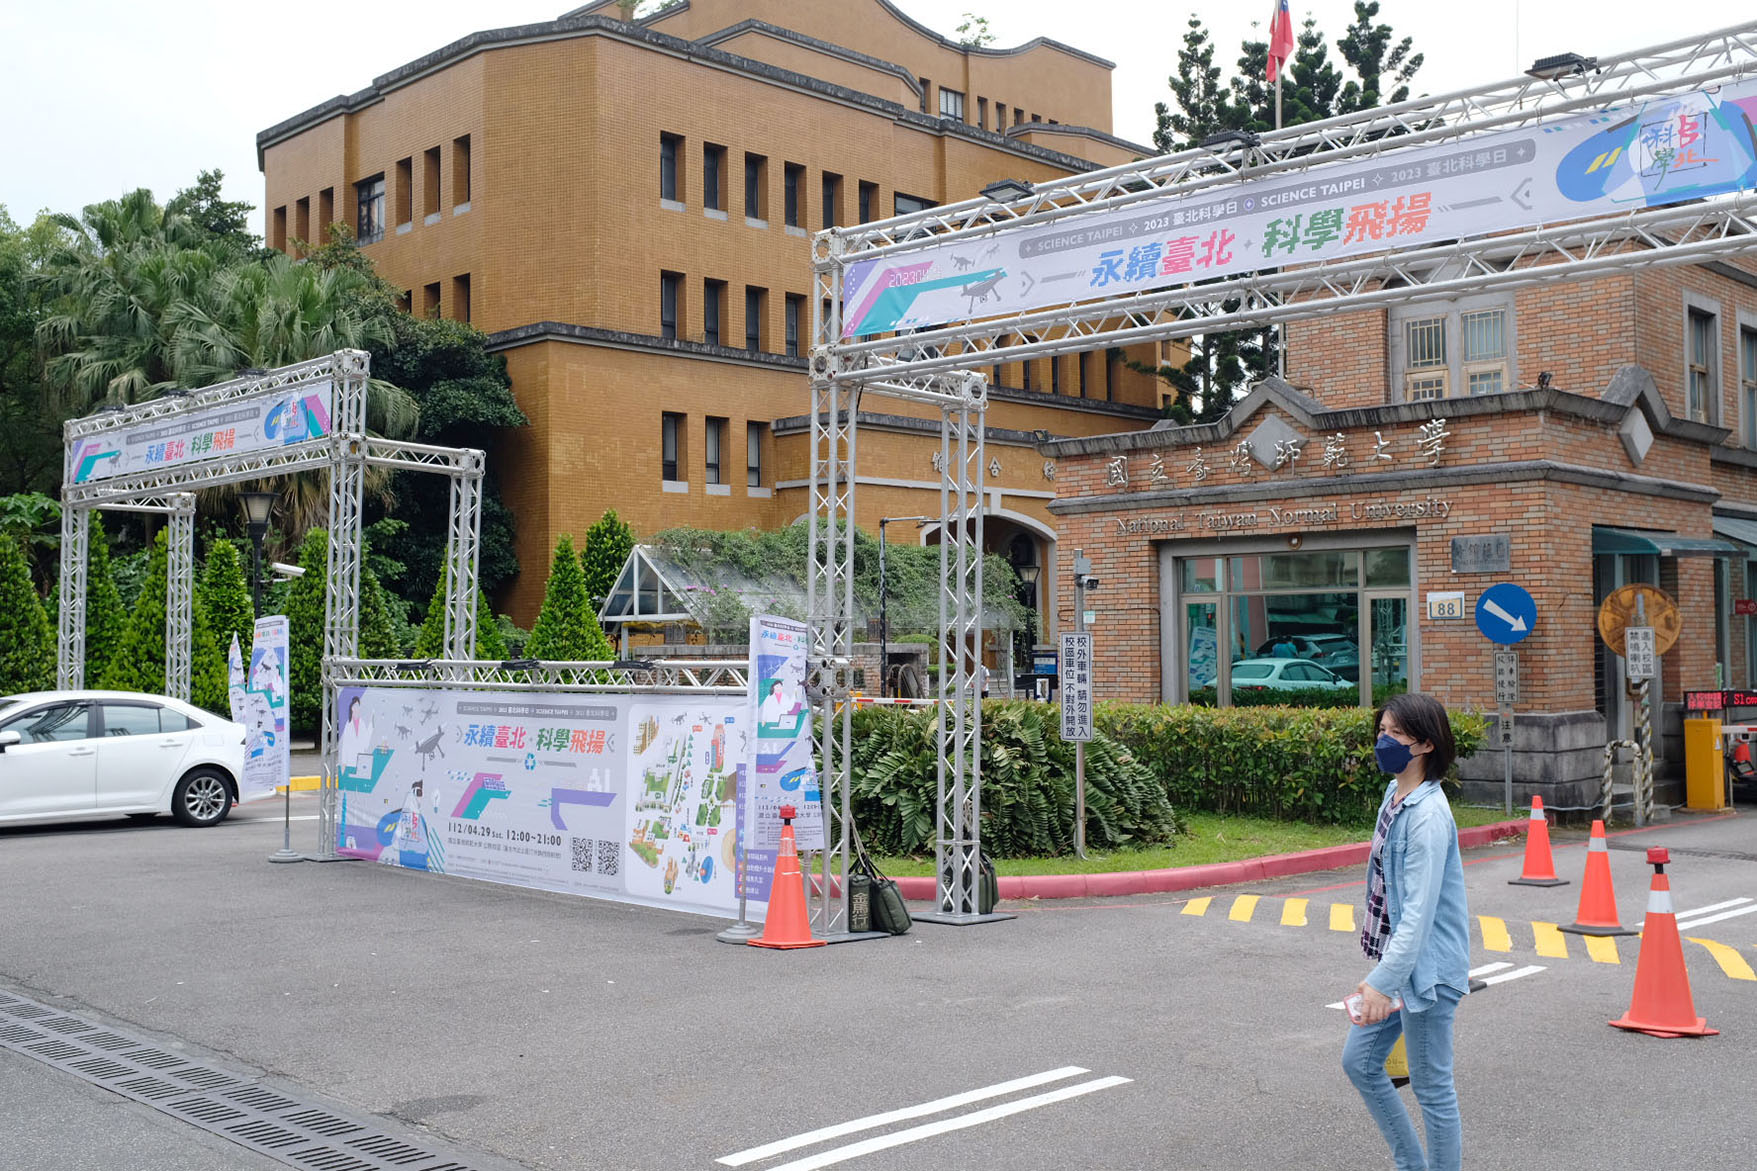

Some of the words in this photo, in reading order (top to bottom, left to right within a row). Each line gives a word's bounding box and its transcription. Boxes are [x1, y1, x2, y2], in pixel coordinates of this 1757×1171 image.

[1391, 168, 1422, 183] 2023
[1426, 149, 1507, 177] 臺北科學日
[1260, 186, 1317, 207] SCIENCE
[1320, 177, 1365, 197] TAIPEI
[1143, 218, 1170, 232] 2023
[1172, 201, 1238, 226] 臺北科學日
[1037, 232, 1084, 251] SCIENCE
[1087, 225, 1123, 243] TAIPEI
[1089, 228, 1236, 288] 永續臺北
[1263, 192, 1432, 258] 科學飛揚
[1116, 512, 1186, 537] National
[1195, 509, 1258, 531] Taiwan
[1268, 502, 1338, 527] Normal
[1349, 495, 1453, 521] University
[1438, 602, 1455, 616] 88
[1065, 637, 1075, 680] 校區車位
[1076, 637, 1088, 685] 校外車輛
[1065, 683, 1076, 737] 不對外開放
[1076, 689, 1088, 737] 請勿進入
[464, 724, 526, 749] 永續臺北
[536, 727, 606, 754] 科學飛揚
[1501, 720, 1512, 743] 注意
[448, 821, 491, 837] 112/04.29
[506, 829, 562, 847] 12:00~21:00
